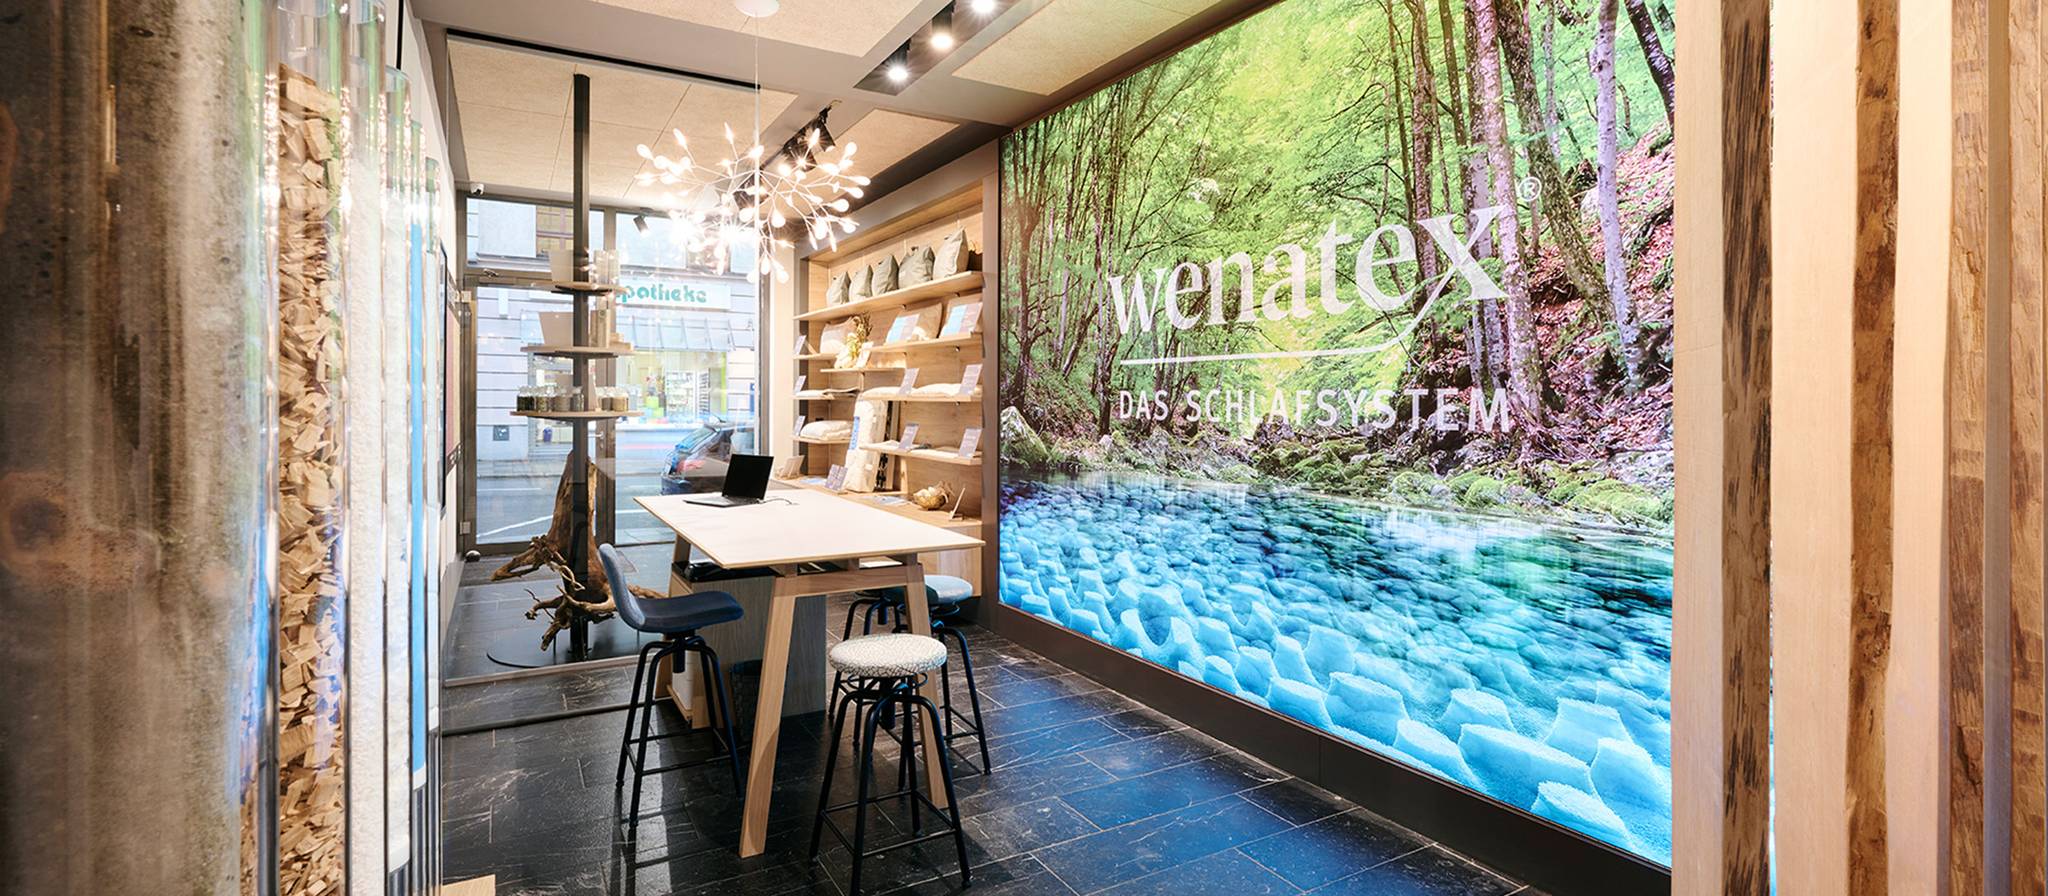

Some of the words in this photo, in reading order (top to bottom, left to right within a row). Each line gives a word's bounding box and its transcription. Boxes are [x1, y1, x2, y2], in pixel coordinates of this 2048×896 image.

[616, 284, 707, 304] potheke
[1119, 389, 1169, 422] DAS
[1186, 386, 1510, 432] SCHLAFSYSTEM
